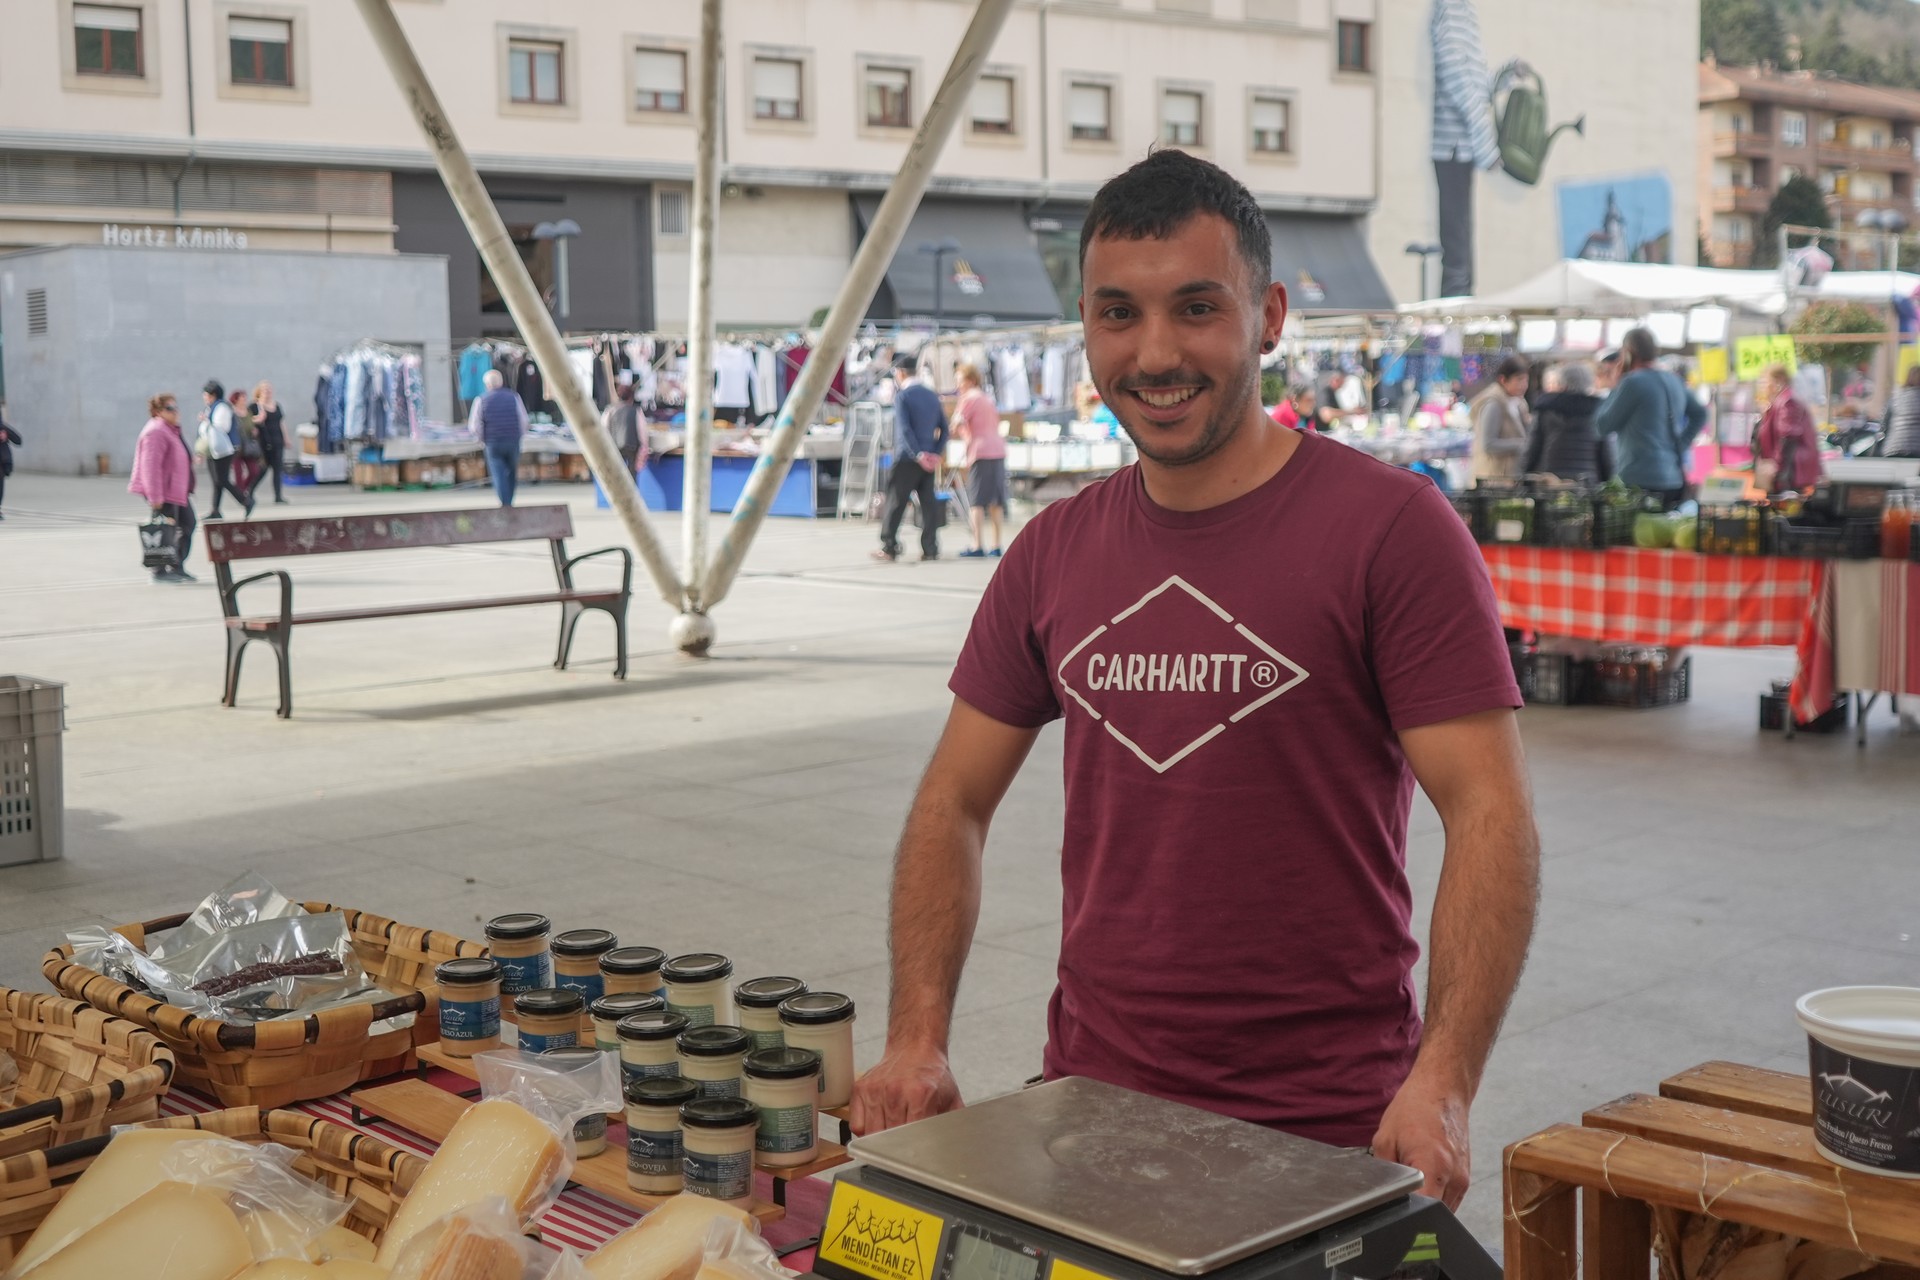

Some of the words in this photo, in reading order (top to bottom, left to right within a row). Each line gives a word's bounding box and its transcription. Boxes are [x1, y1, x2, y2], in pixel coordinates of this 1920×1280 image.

[103, 223, 167, 246] Hortz
[1087, 653, 1248, 693] CARHARTT
[1818, 1089, 1893, 1128] LUSURI
[757, 1139, 774, 1147] VEJA
[1849, 1132, 1869, 1146] Queso
[1870, 1138, 1893, 1151] Fresco
[642, 1163, 667, 1172] OVEJA
[688, 1184, 712, 1195] OVEJA
[841, 1234, 901, 1270] MENDIETAN
[902, 1257, 916, 1276] EZ
